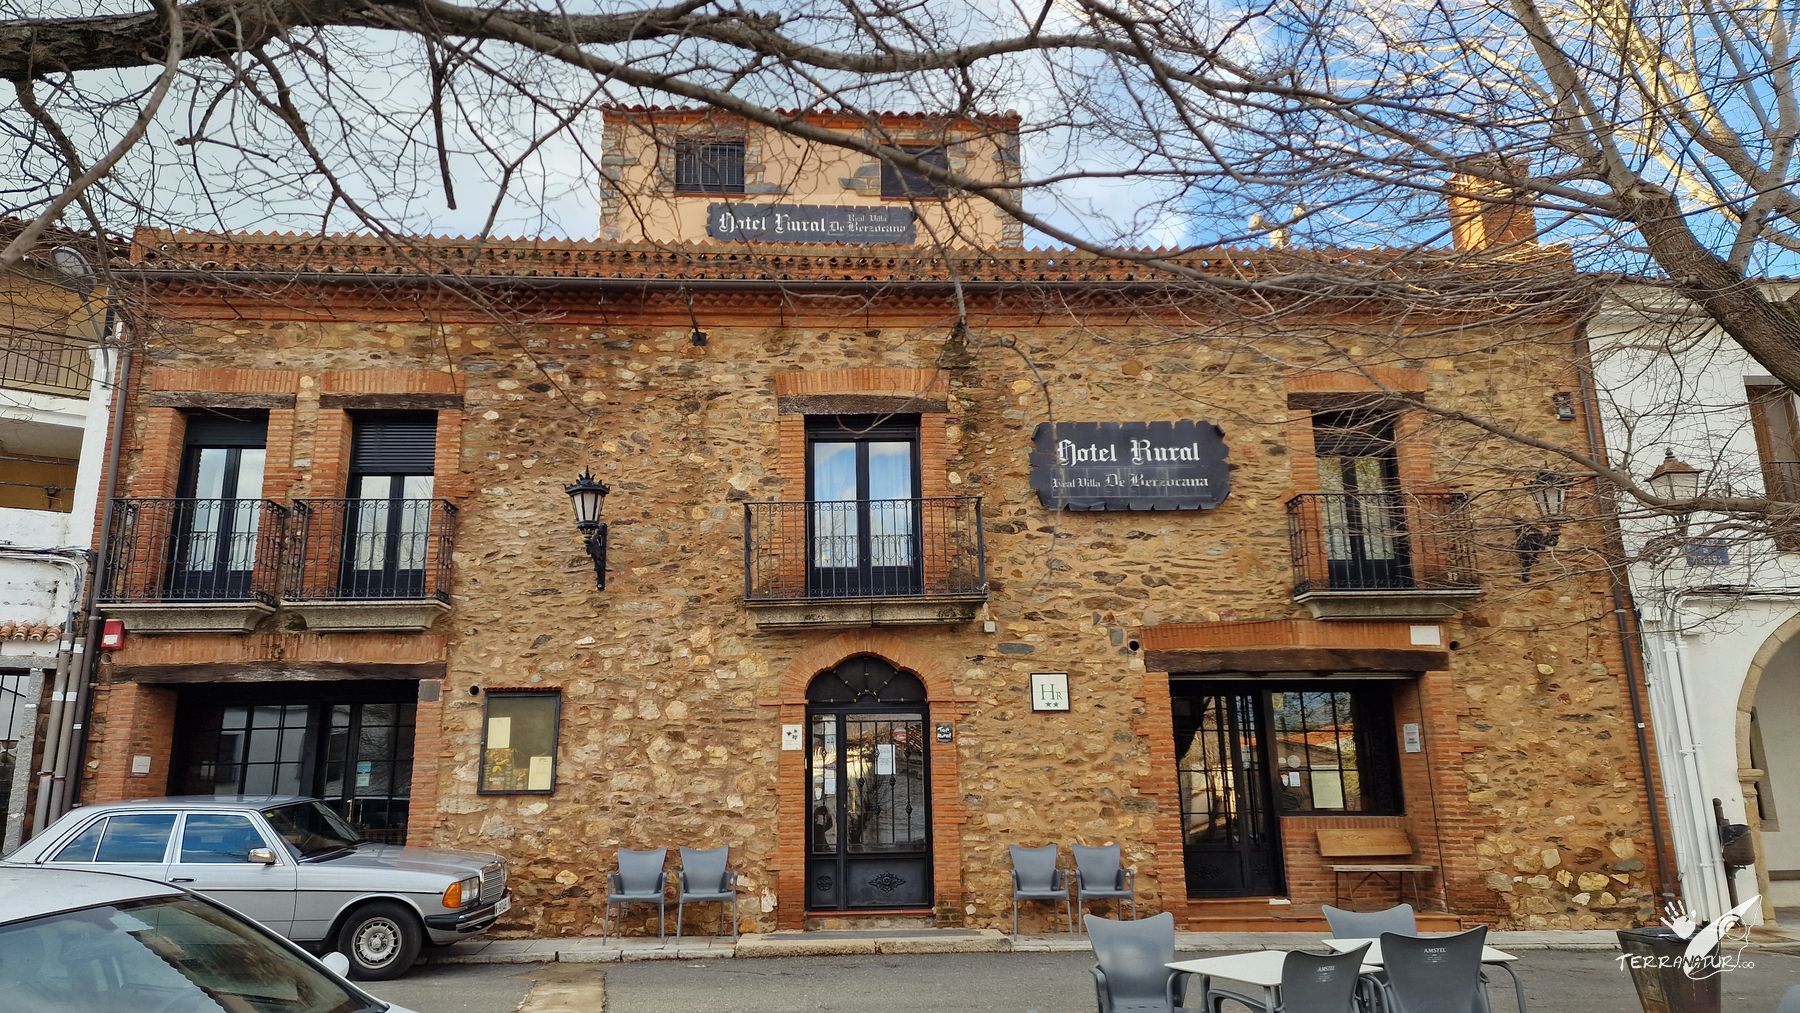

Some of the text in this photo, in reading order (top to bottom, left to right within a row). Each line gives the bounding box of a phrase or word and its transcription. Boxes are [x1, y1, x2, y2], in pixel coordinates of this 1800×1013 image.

[1057, 439, 1201, 467] Hotel Rural
[1077, 478, 1101, 488] Villa
[1104, 473, 1126, 488] De
[1129, 473, 1209, 488] Berzocana
